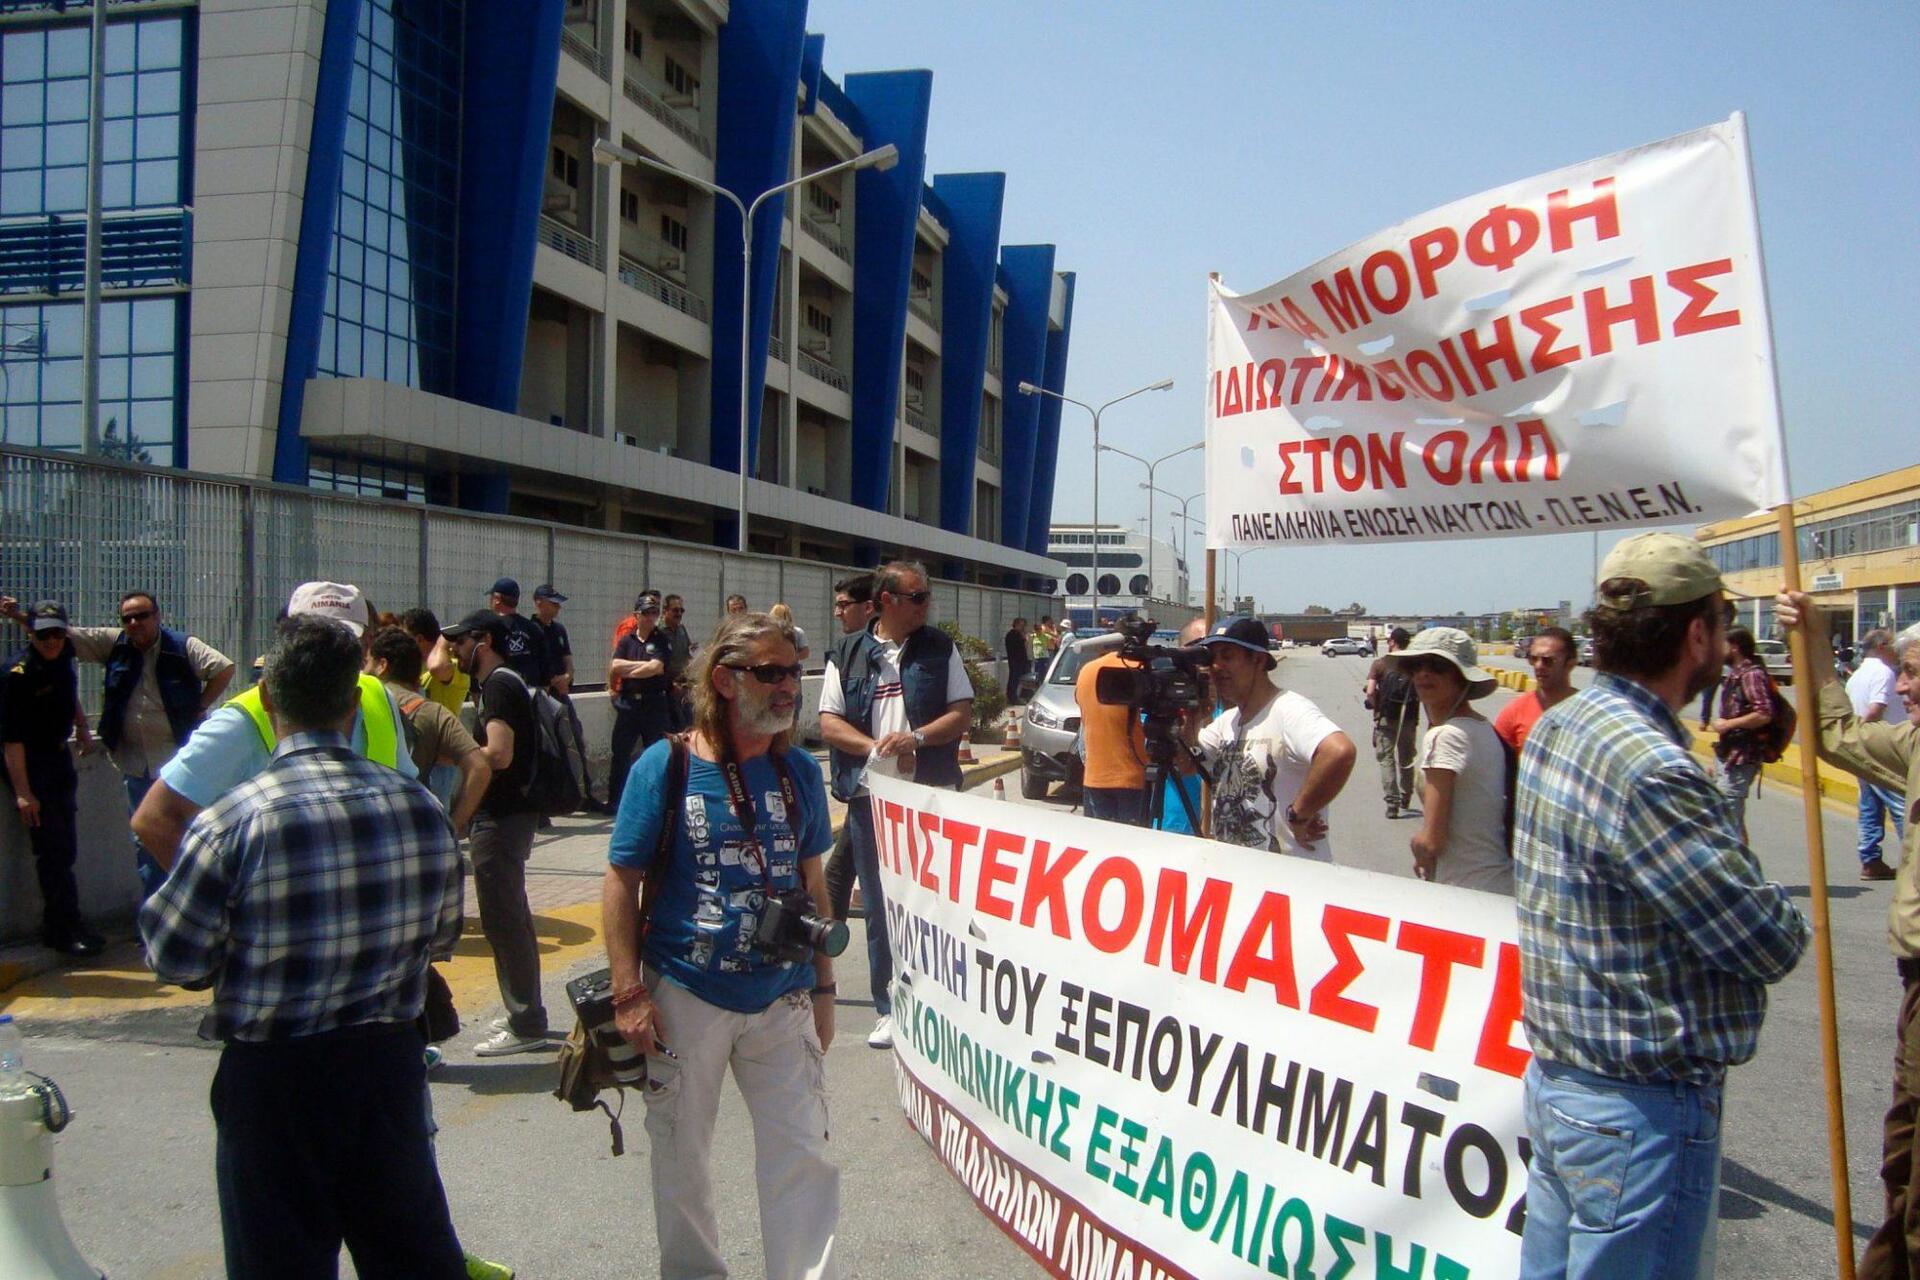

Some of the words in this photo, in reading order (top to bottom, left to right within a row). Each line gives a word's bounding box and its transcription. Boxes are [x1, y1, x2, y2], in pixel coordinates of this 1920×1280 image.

[1311, 175, 1620, 334] ΜΟΡΦΗ
[1278, 431, 1406, 495] ΣΤΟΝ
[1422, 418, 1560, 486] ΟΛΠ
[1232, 509, 1346, 541] ΠΑΝΕΛΛΗΝΙΑ
[1343, 506, 1424, 537] ΕΝΩΣΗ
[1421, 500, 1532, 535] ΝΑΥΤΩΝ
[1545, 481, 1702, 526] Π.Ε.Ν.Ε.Ν.
[727, 762, 745, 802] Canon
[975, 948, 1047, 1037] ΤΟΥ
[911, 994, 1081, 1163] ΚΟΙΝΩΝΙΚΗΣ
[938, 1103, 1061, 1260] ΥΠΑΛΛΗΛΩΝ
